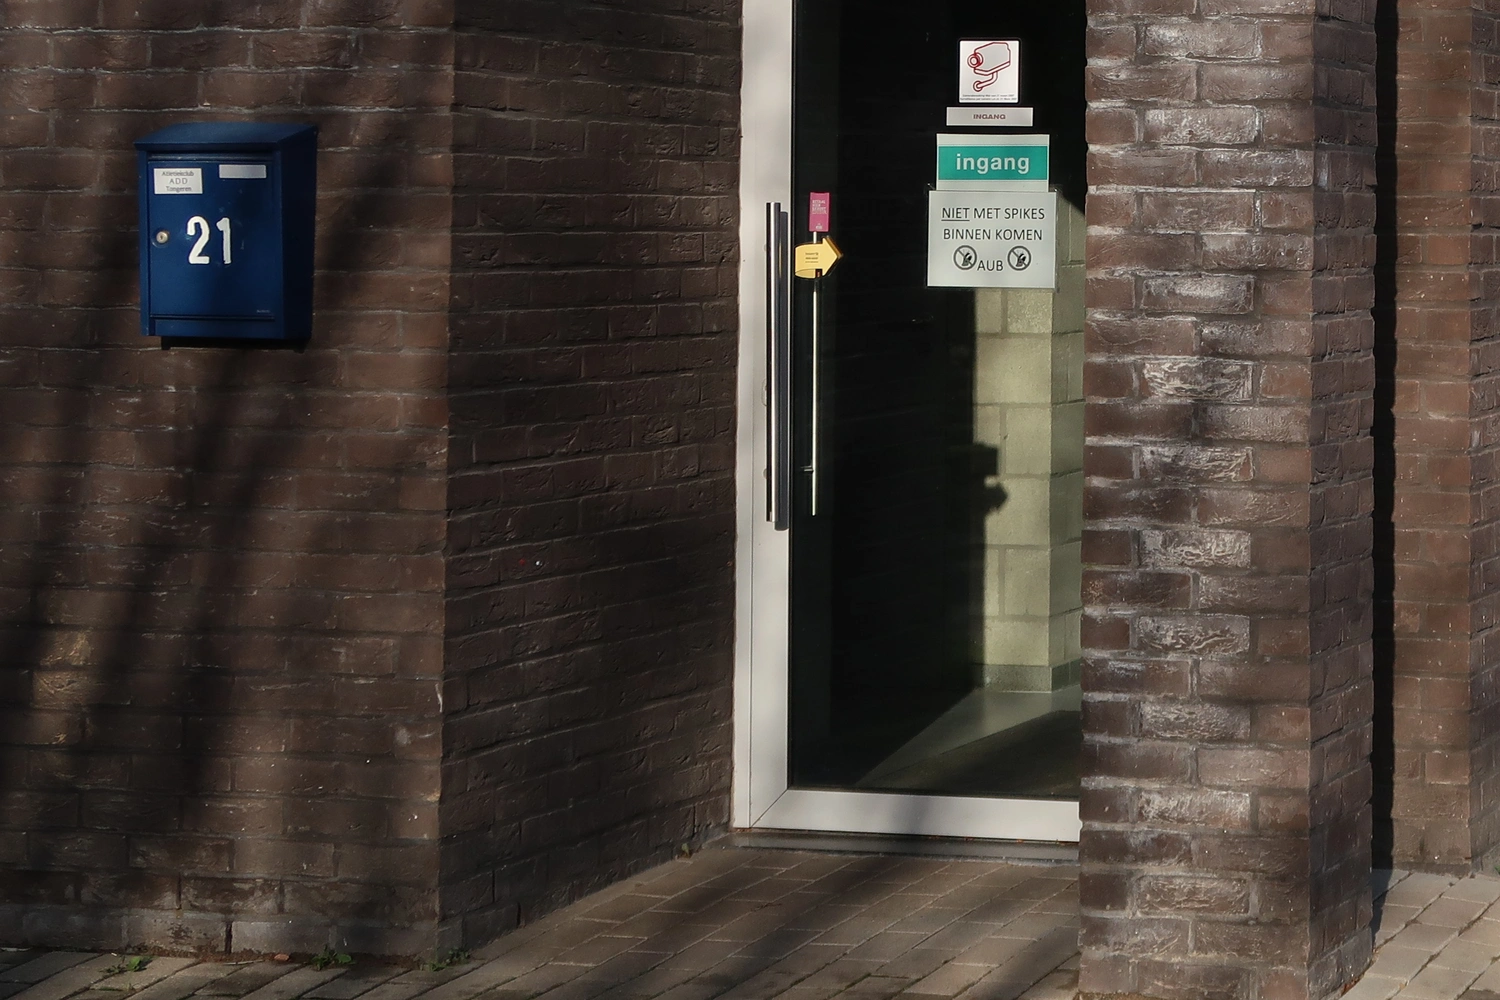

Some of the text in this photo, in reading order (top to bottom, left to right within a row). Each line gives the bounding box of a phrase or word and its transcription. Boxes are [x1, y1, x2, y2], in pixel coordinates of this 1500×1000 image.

[956, 153, 1030, 174] ingang
[941, 207, 1045, 220] NIET MET SPIKES
[186, 215, 232, 265] 21
[943, 228, 1043, 241] BINNEN KOMEN
[977, 260, 1004, 272] AUB
